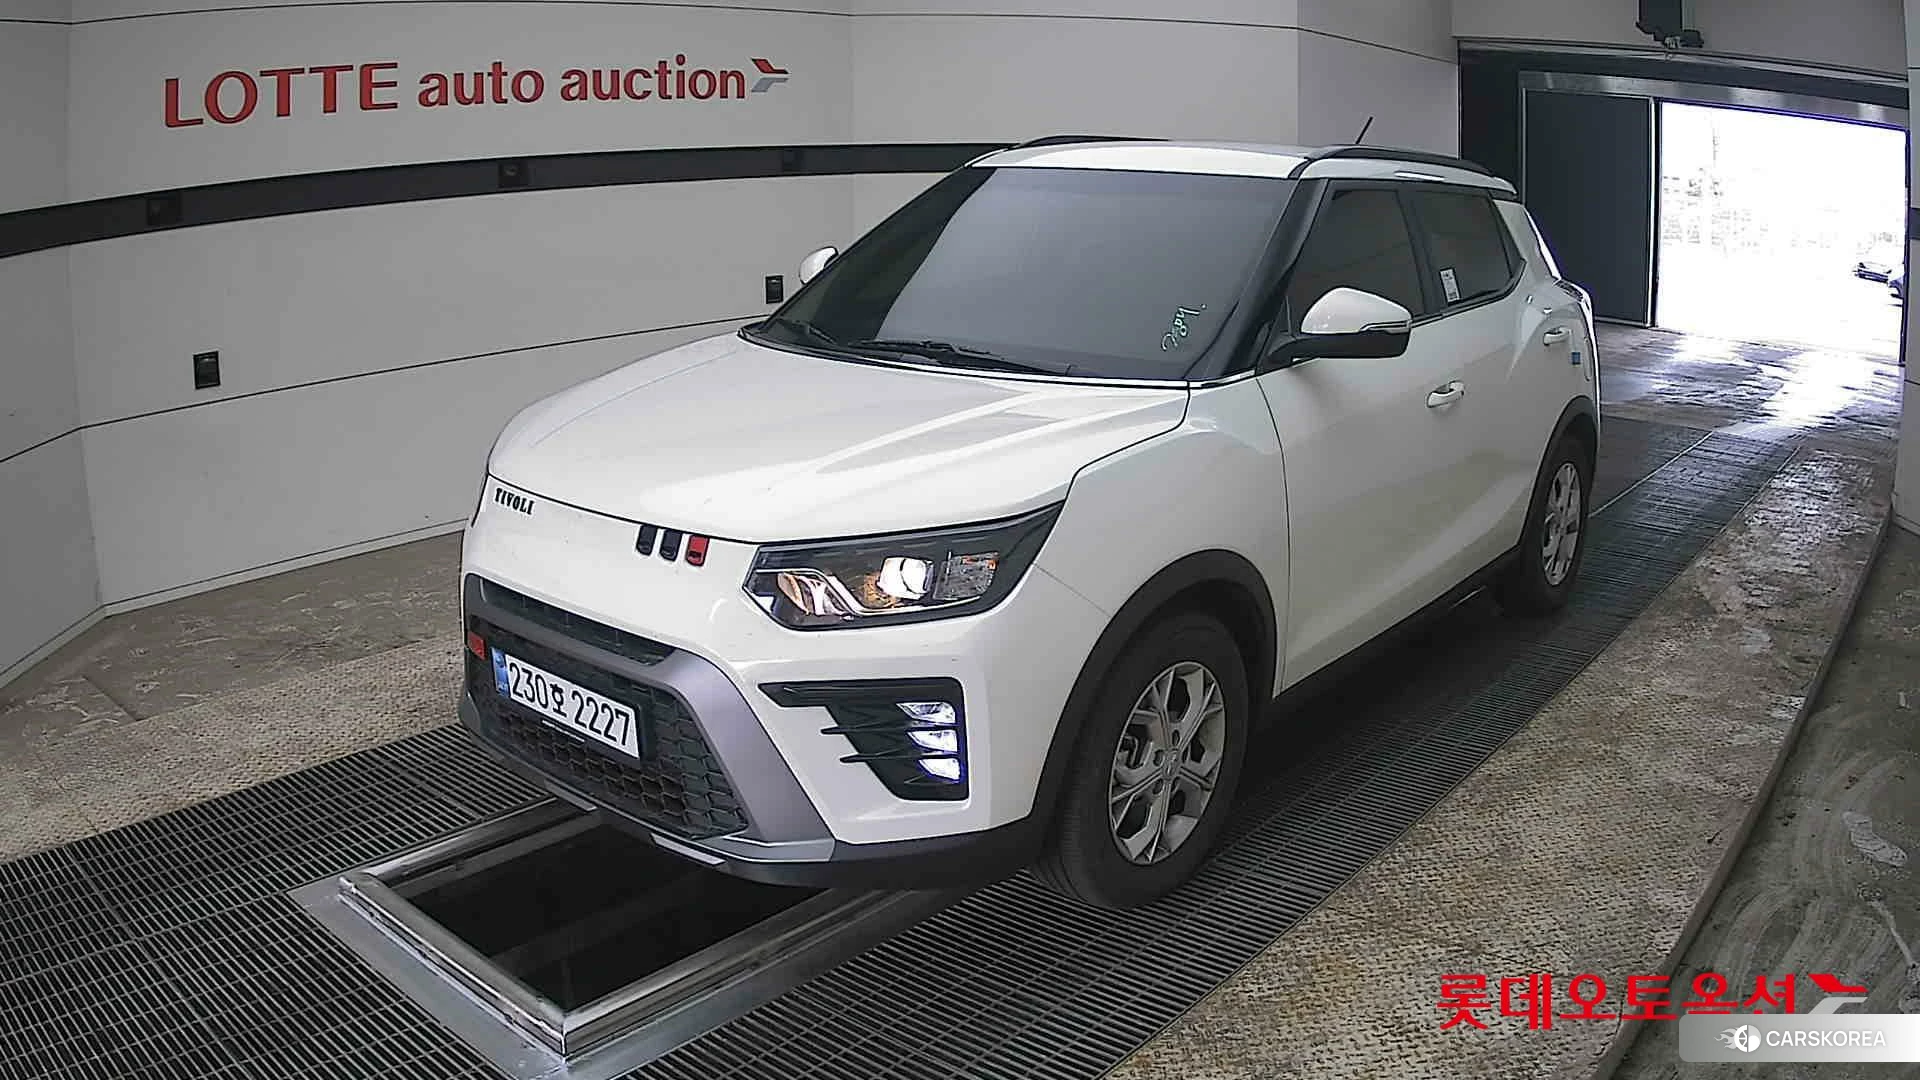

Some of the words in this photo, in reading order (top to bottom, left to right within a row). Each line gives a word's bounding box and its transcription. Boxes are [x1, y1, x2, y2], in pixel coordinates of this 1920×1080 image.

[164, 62, 399, 128] LOTTE
[418, 61, 544, 108] auto
[560, 54, 746, 101] auction
[494, 487, 535, 515] TIVOLI
[509, 662, 568, 718] 230호
[571, 690, 630, 746] 2227
